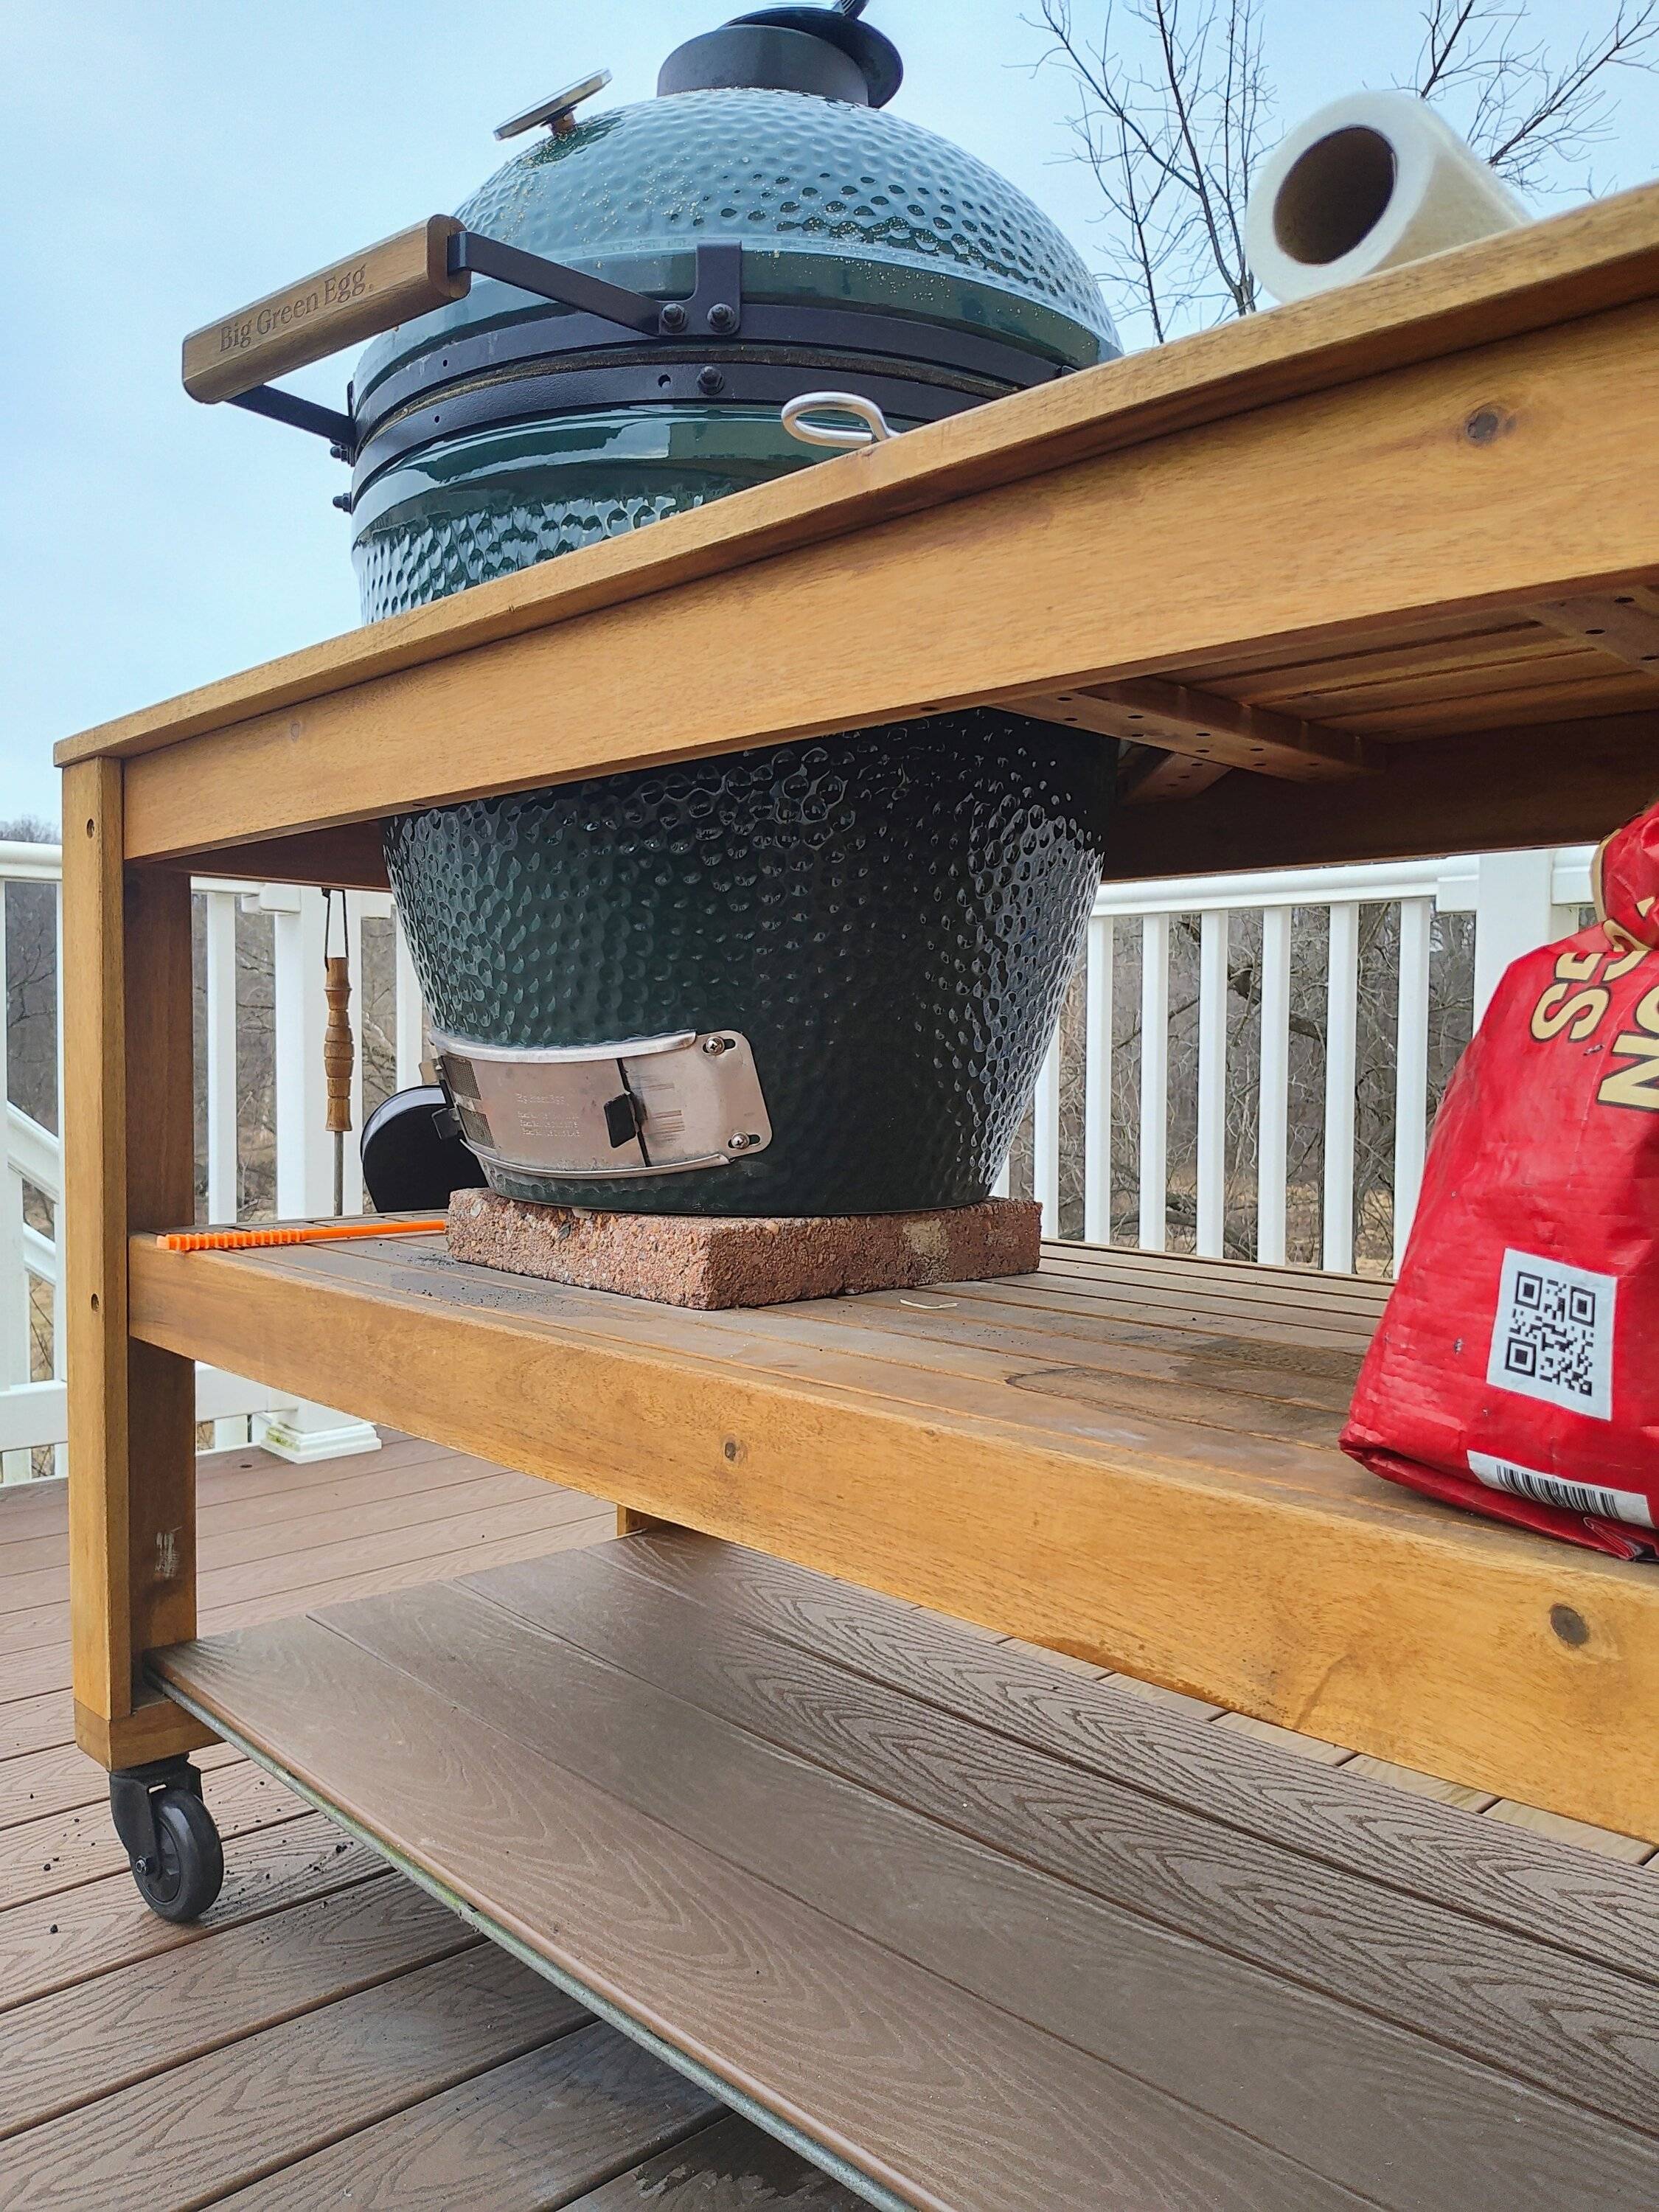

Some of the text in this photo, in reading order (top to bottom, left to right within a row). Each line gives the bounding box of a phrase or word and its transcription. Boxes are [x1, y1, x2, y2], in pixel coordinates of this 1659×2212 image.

[220, 262, 367, 352] Big Green Egg
